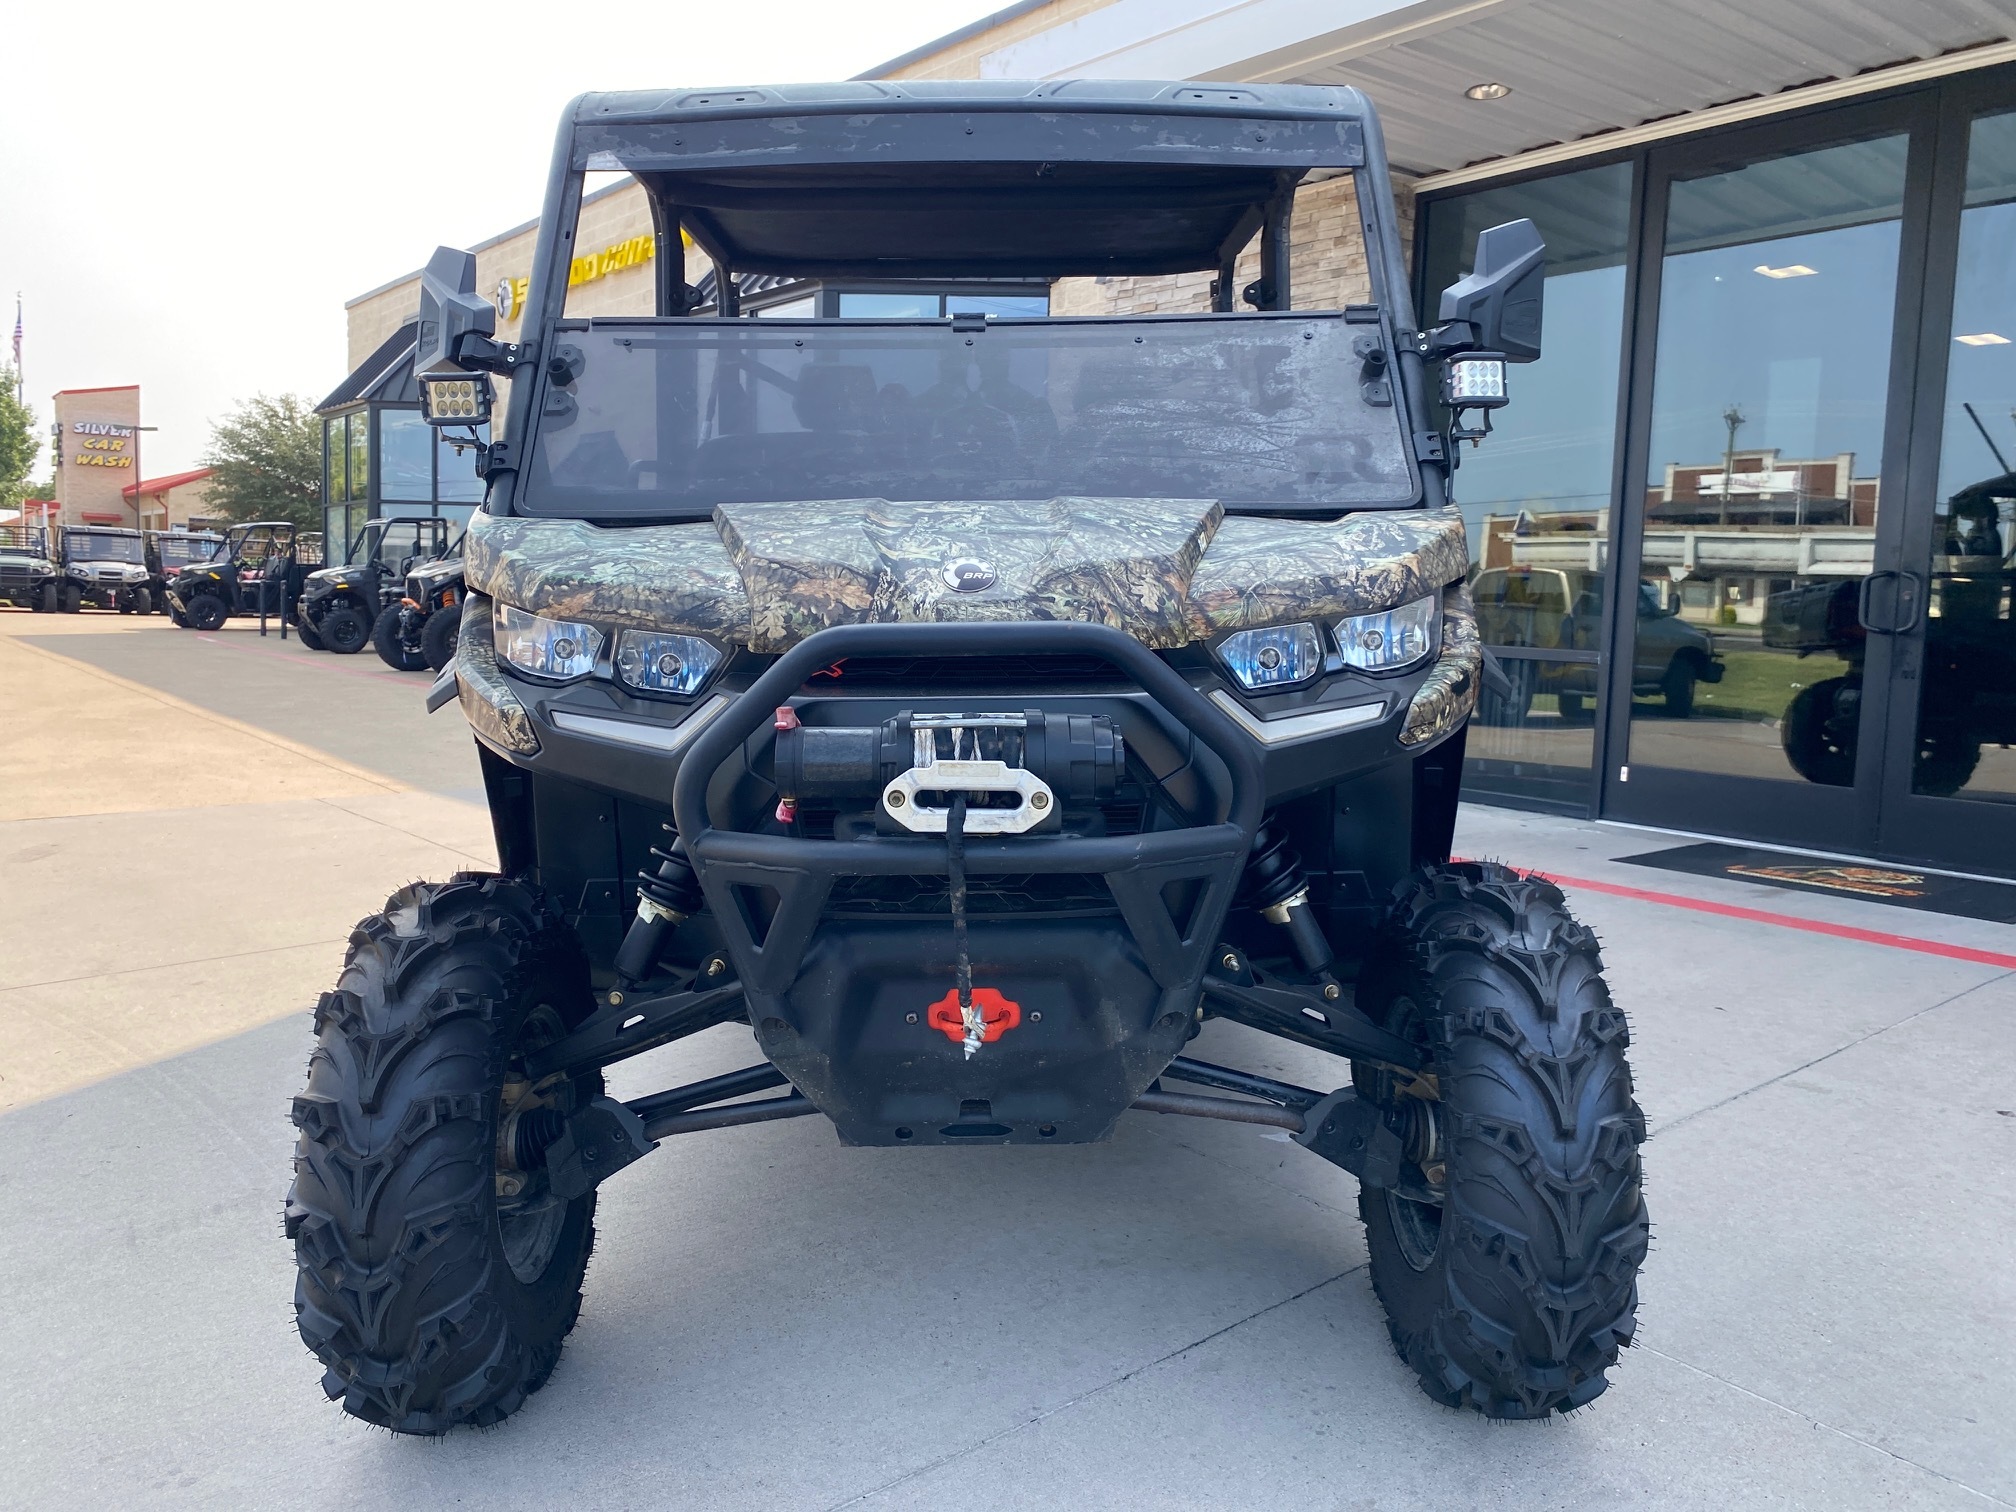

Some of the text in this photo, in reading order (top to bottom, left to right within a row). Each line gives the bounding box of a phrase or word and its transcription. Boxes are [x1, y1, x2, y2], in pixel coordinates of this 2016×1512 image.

[82, 438, 125, 452] CAR
[75, 454, 133, 468] WASH
[963, 572, 994, 580] BRP
